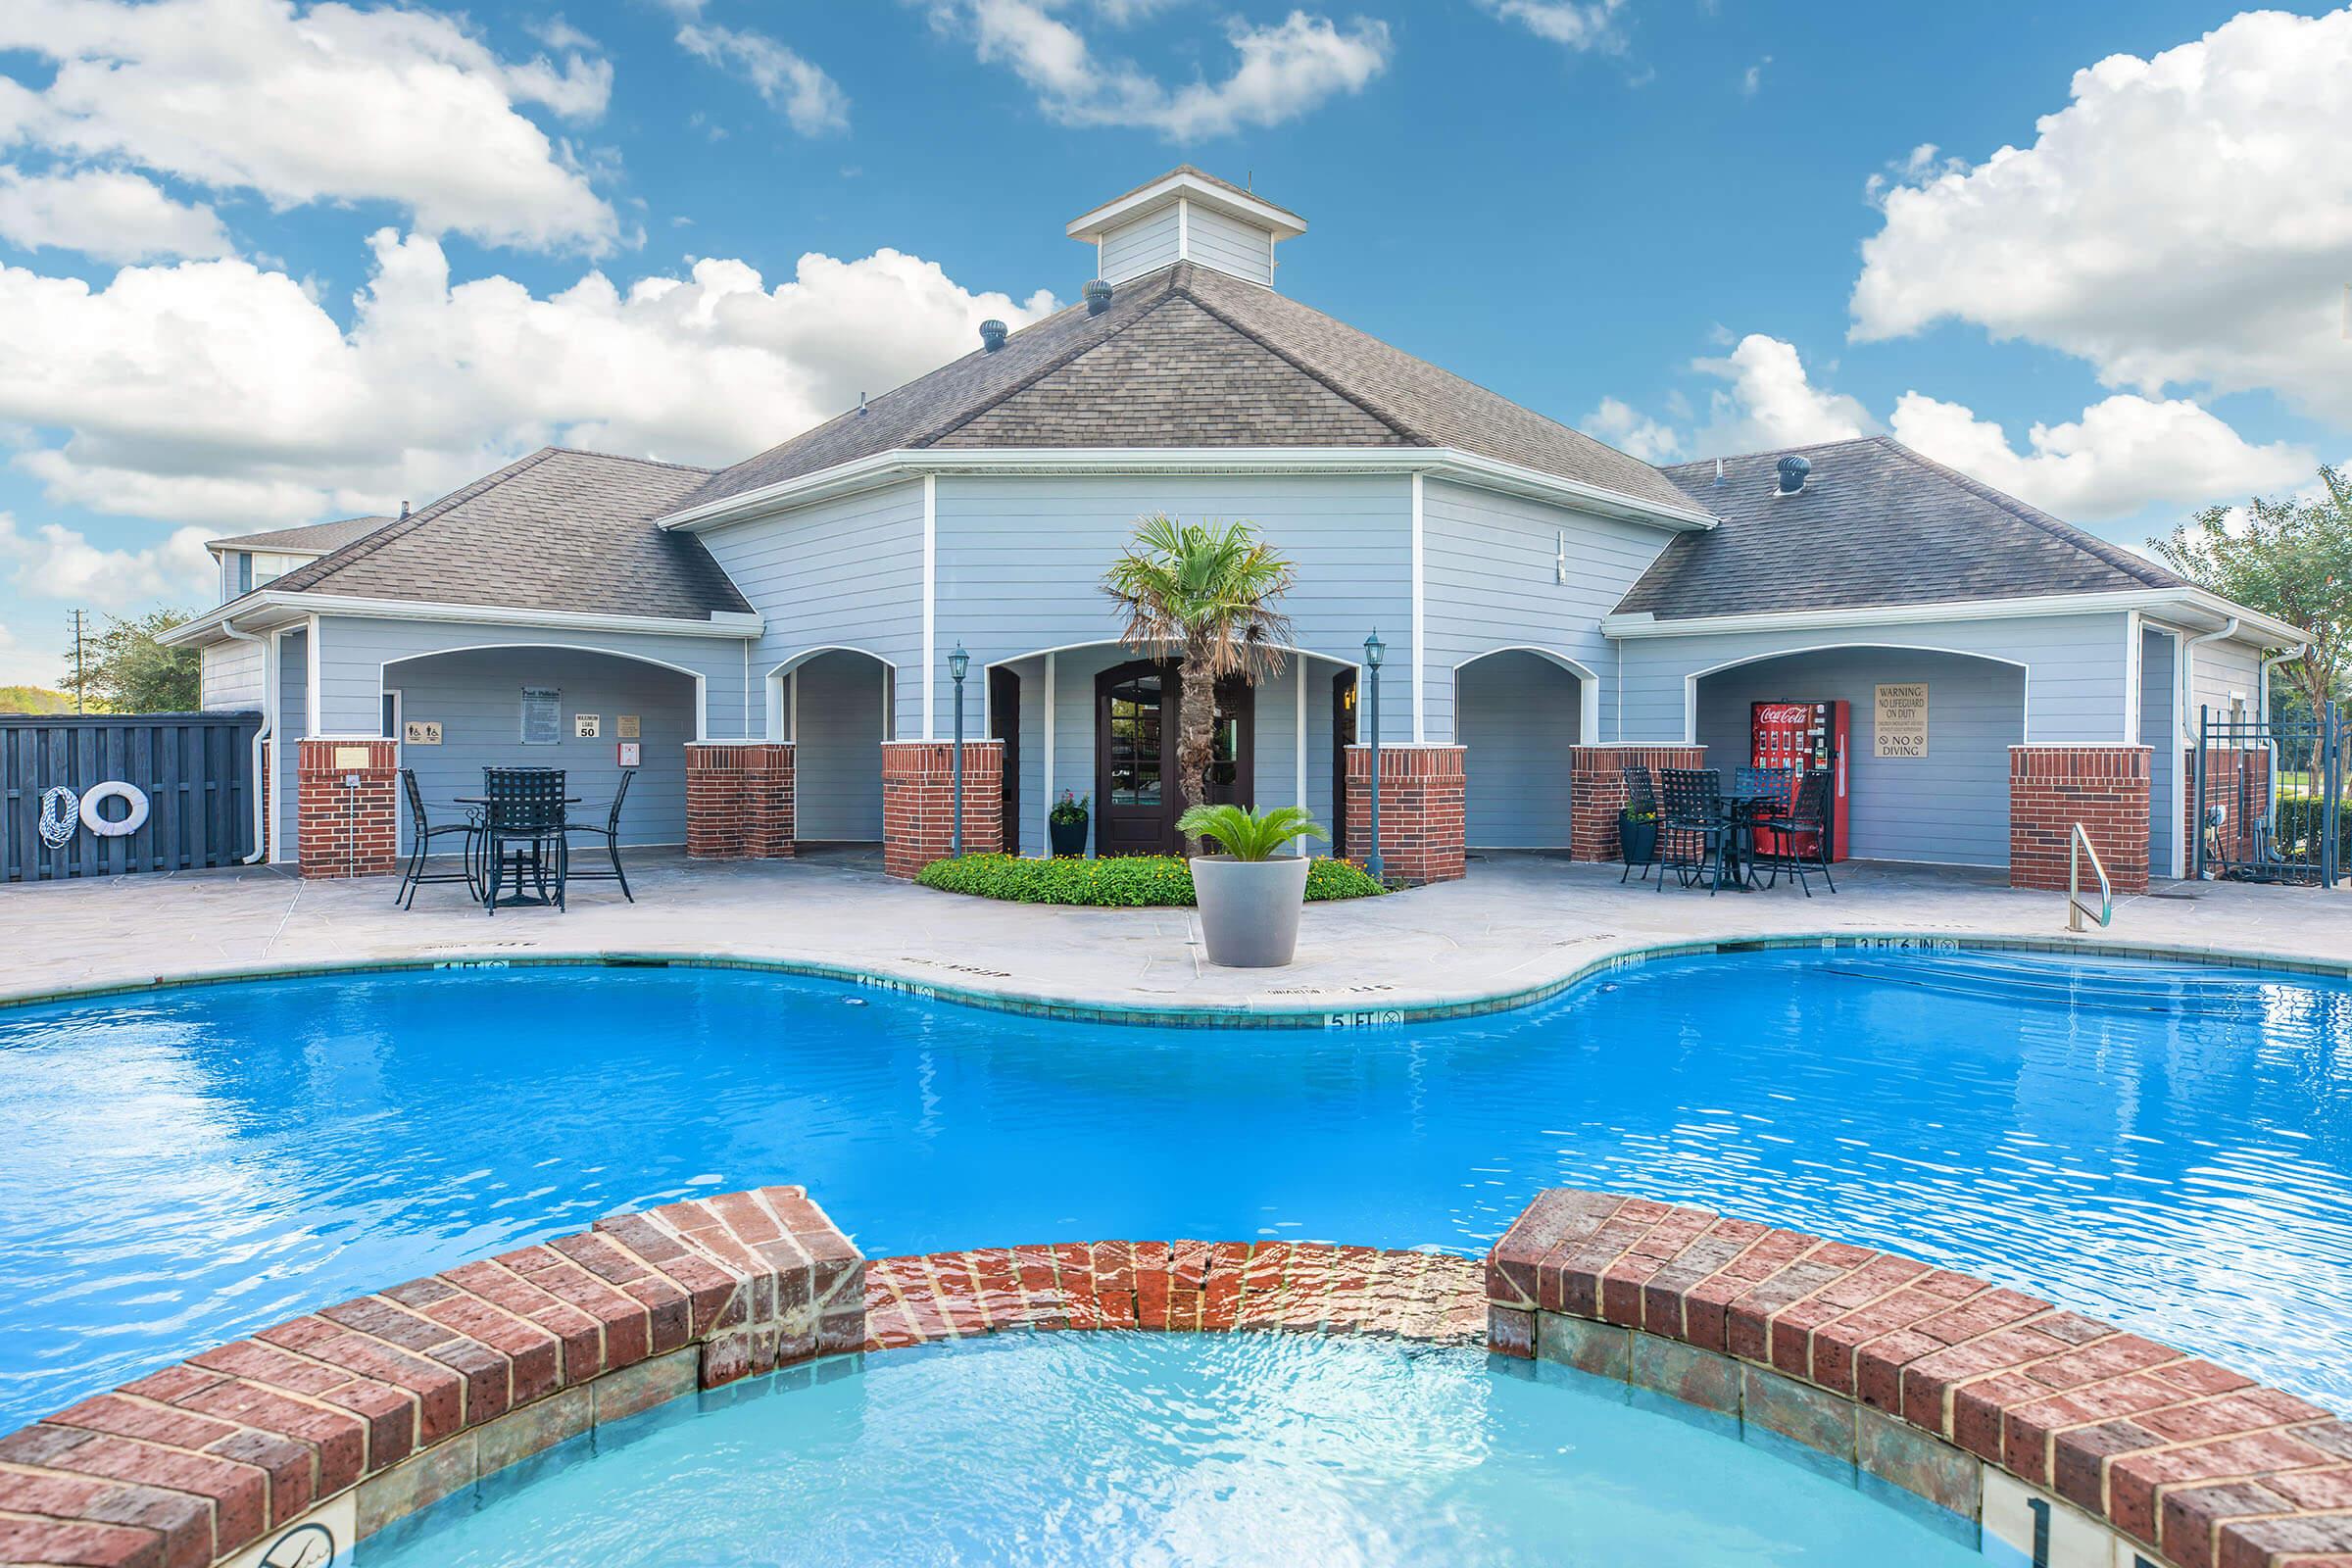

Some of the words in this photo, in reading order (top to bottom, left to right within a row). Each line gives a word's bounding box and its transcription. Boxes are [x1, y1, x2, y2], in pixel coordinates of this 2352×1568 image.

[1880, 687, 1924, 697] WARNING:
[1879, 699, 1888, 708] NO
[1889, 698, 1924, 708] LIFEGUARD
[1886, 709, 1897, 718] ON
[1898, 709, 1915, 718] DUTY
[581, 728, 595, 737] 50
[1892, 736, 1910, 745] NO
[1883, 746, 1919, 756] DIVING
[1332, 1011, 1345, 1026] 5
[1356, 1009, 1374, 1026] FT
